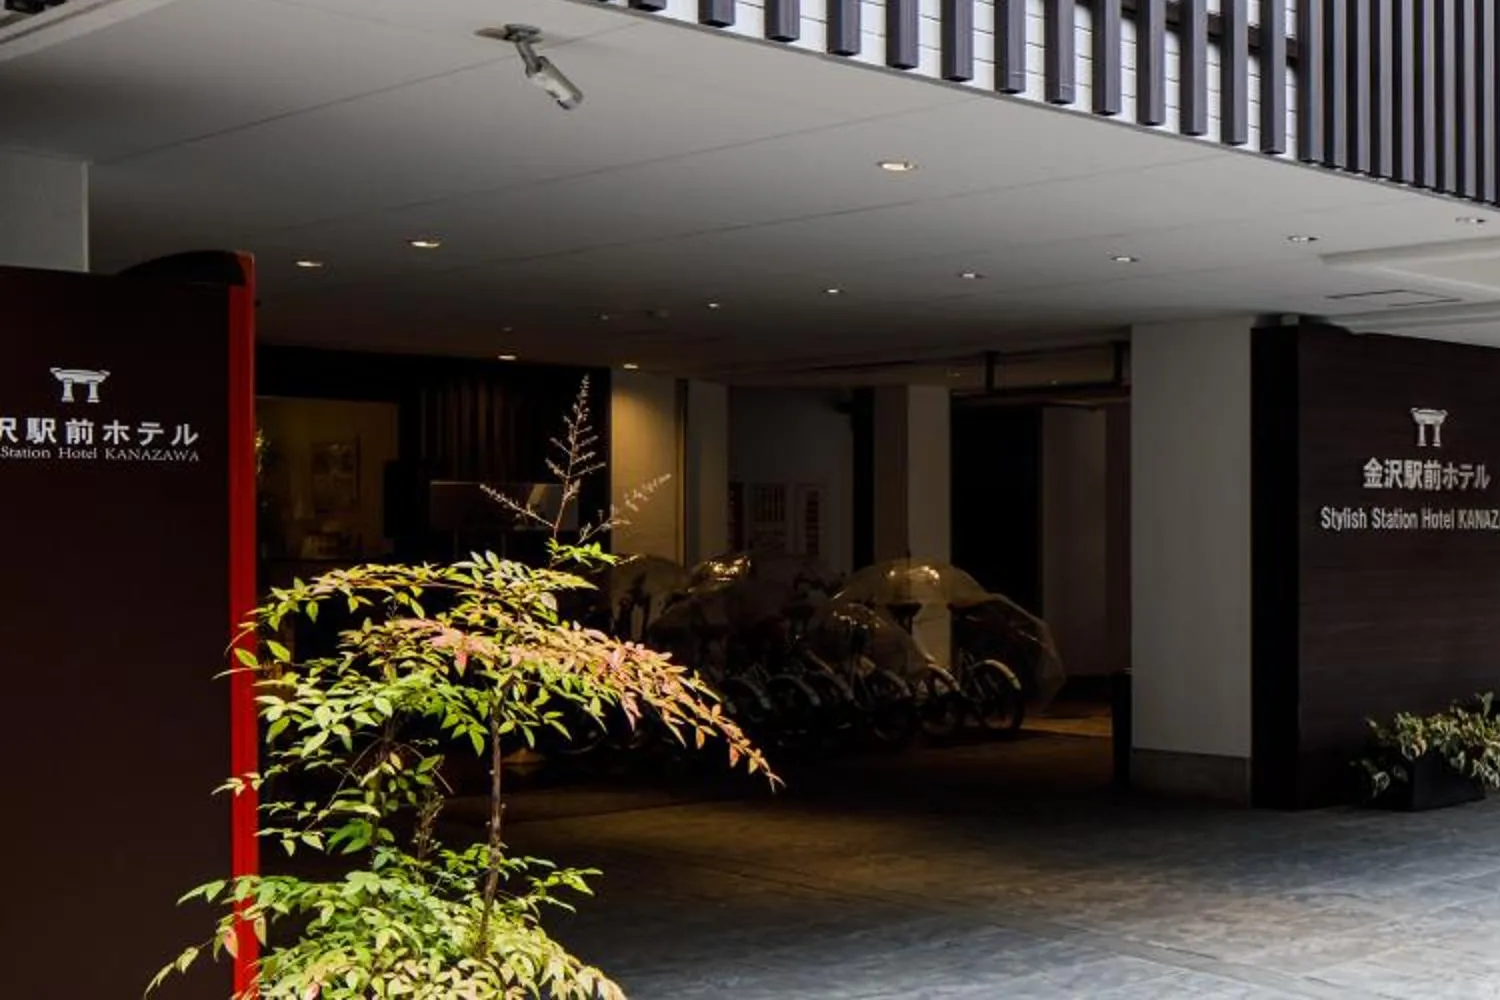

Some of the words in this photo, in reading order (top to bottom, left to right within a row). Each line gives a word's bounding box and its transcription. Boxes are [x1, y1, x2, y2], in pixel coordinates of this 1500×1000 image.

[0, 446, 51, 460] Station
[58, 446, 97, 460] Hotel
[105, 448, 199, 462] KANAZAWA
[1363, 457, 1491, 491] 金沢駅前ホテル
[1320, 506, 1367, 533] Stylish
[1371, 508, 1418, 530] Station
[1422, 508, 1455, 530] Hotel
